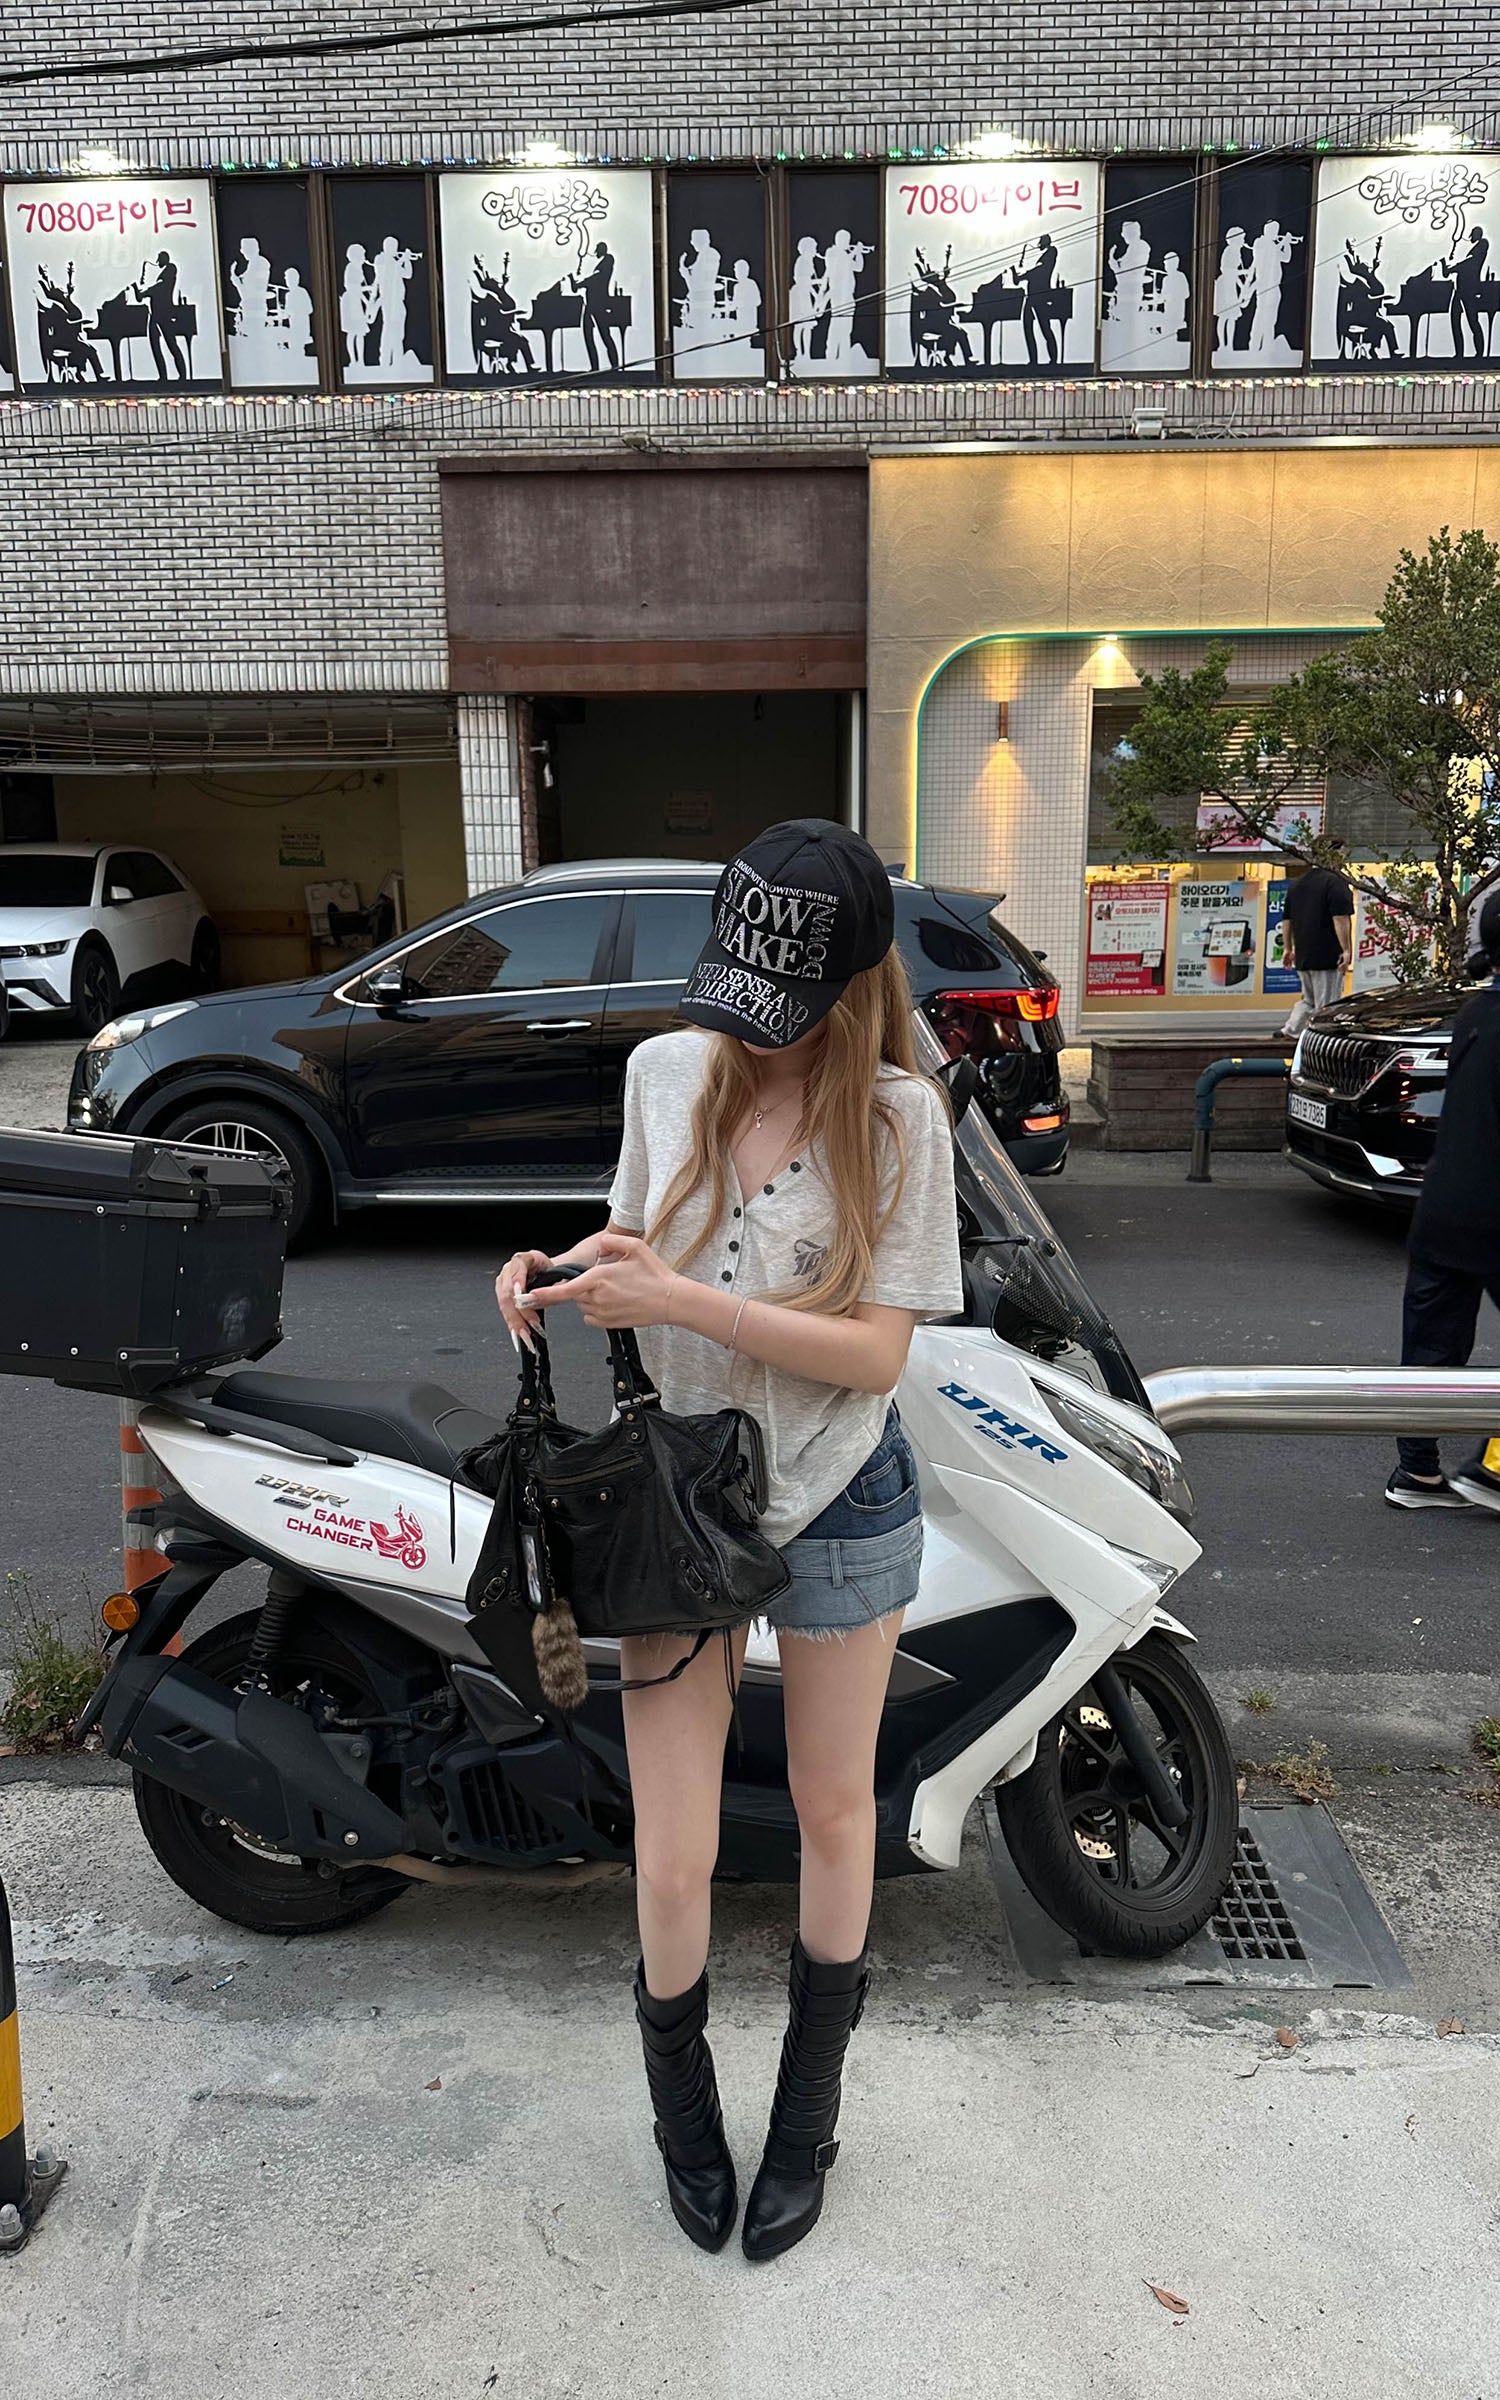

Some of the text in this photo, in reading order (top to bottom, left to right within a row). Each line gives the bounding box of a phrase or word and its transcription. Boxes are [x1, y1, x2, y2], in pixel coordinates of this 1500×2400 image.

[17, 198, 197, 234] 7080라이브
[722, 867, 817, 936] SLOW
[749, 871, 762, 884] NOT
[760, 880, 804, 898] KNOWING
[805, 890, 840, 905] WHERE
[1180, 897, 1199, 908] 주문
[1181, 885, 1229, 896] 하이오더가
[714, 902, 805, 977] MAKE
[724, 968, 776, 1001] SENSE
[695, 979, 799, 1040] DIRECTION
[717, 1002, 740, 1016] makes
[752, 1019, 772, 1036] heart
[974, 1425, 1017, 1449] 125
[286, 1517, 373, 1551] CHANGER
[313, 1508, 366, 1532] GAME
